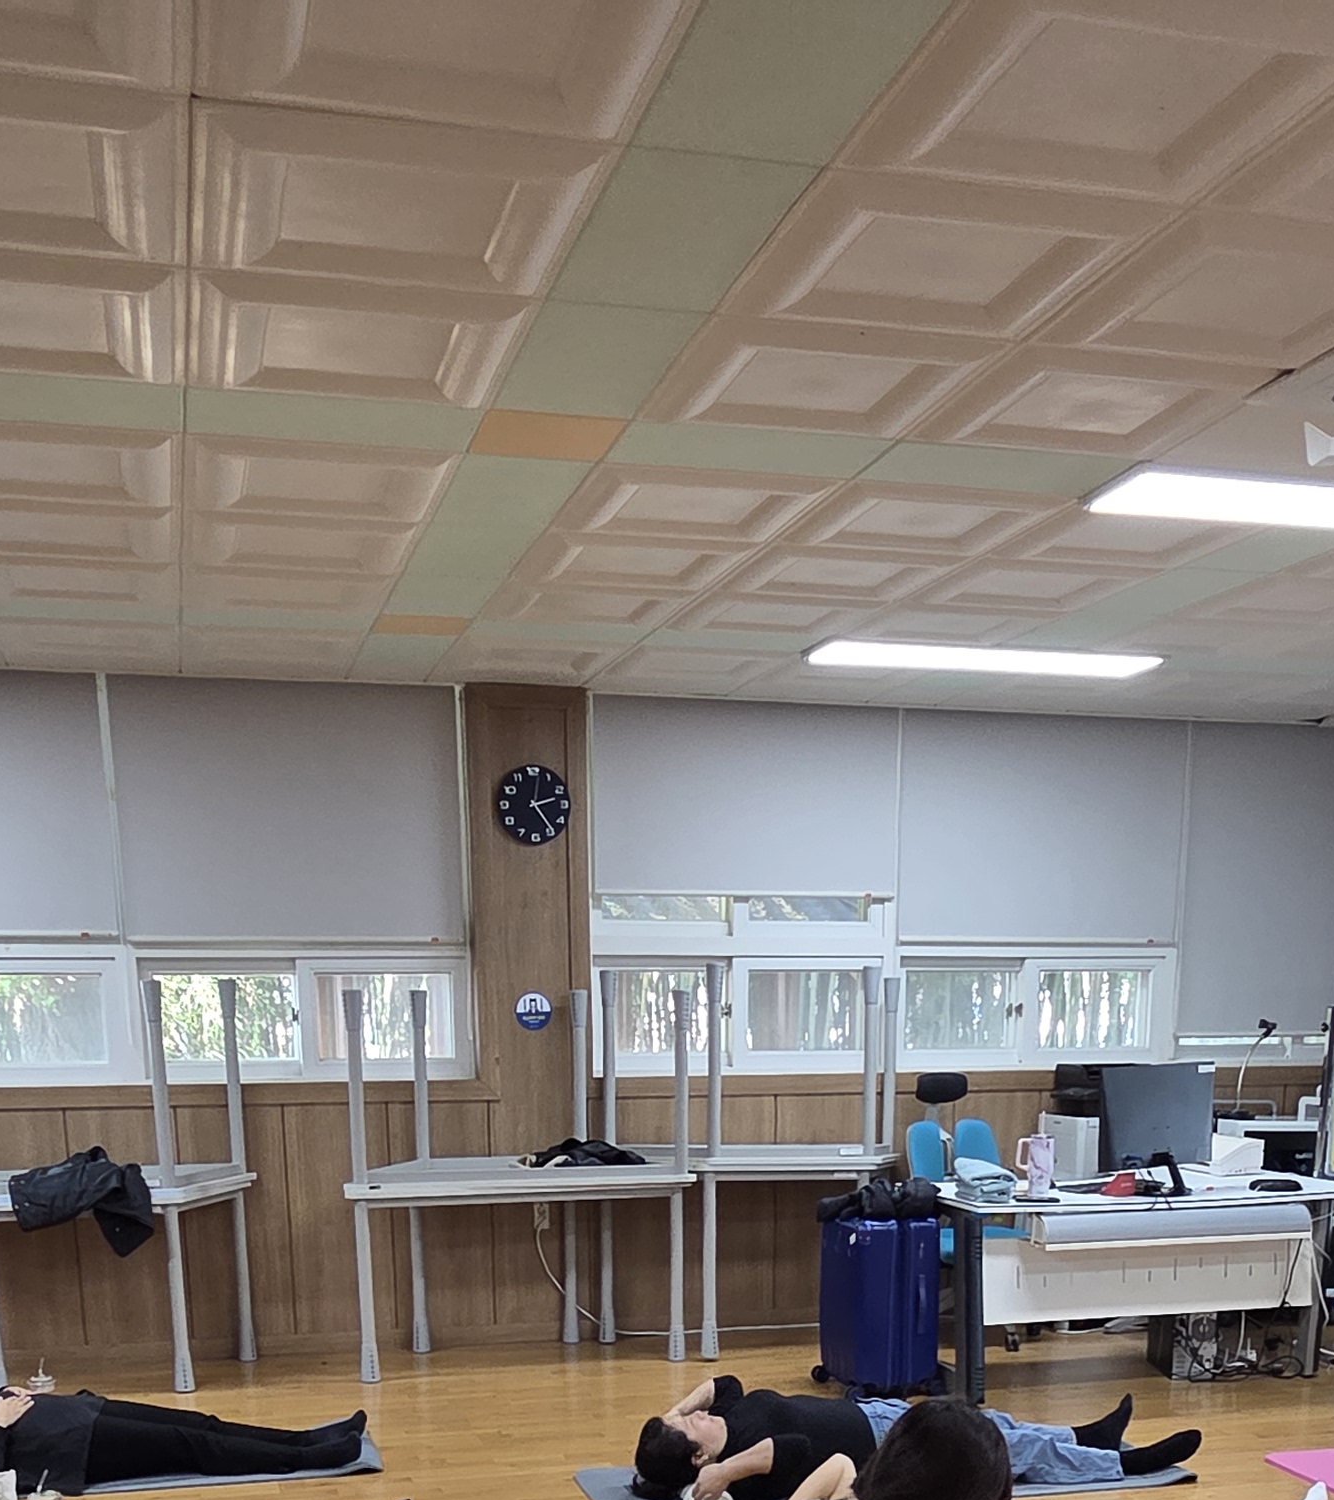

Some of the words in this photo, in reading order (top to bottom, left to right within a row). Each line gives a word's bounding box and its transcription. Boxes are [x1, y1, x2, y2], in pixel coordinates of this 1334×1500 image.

[513, 773, 523, 782] 11
[503, 785, 517, 795] 10
[556, 815, 565, 824] 4
[517, 828, 526, 837] 7
[531, 833, 541, 842] 6
